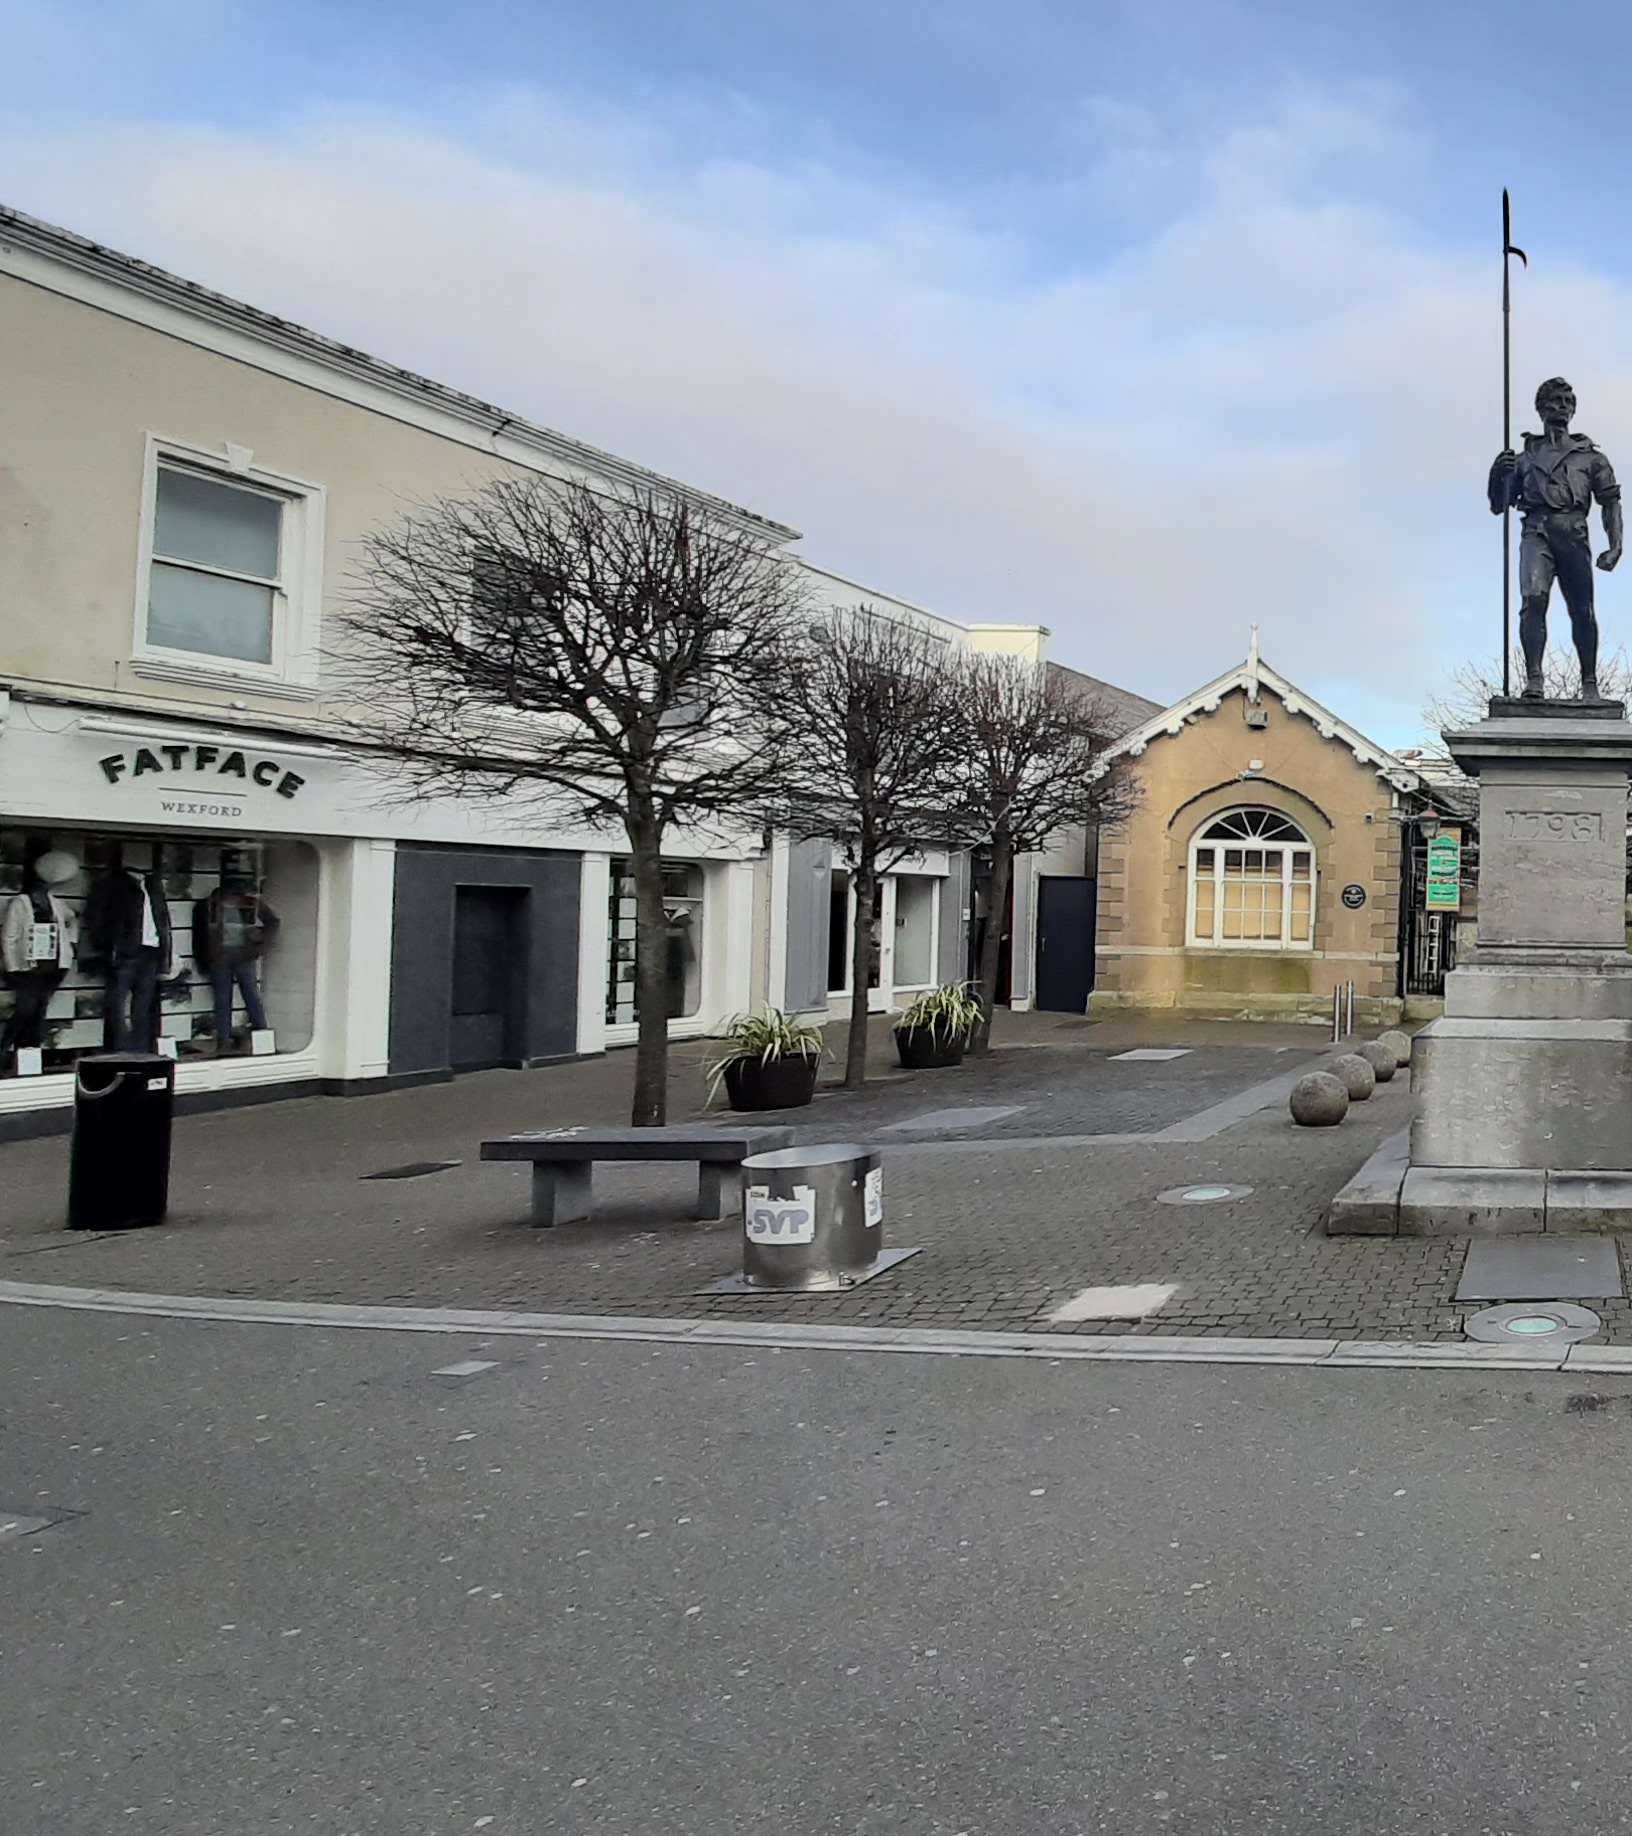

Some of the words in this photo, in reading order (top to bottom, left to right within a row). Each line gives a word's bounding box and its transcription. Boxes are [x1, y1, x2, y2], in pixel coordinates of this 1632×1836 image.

[99, 745, 306, 799] FATFACE
[161, 801, 242, 817] WEXFORD
[1505, 815, 1595, 840] 1798
[753, 1209, 809, 1234] SVP
